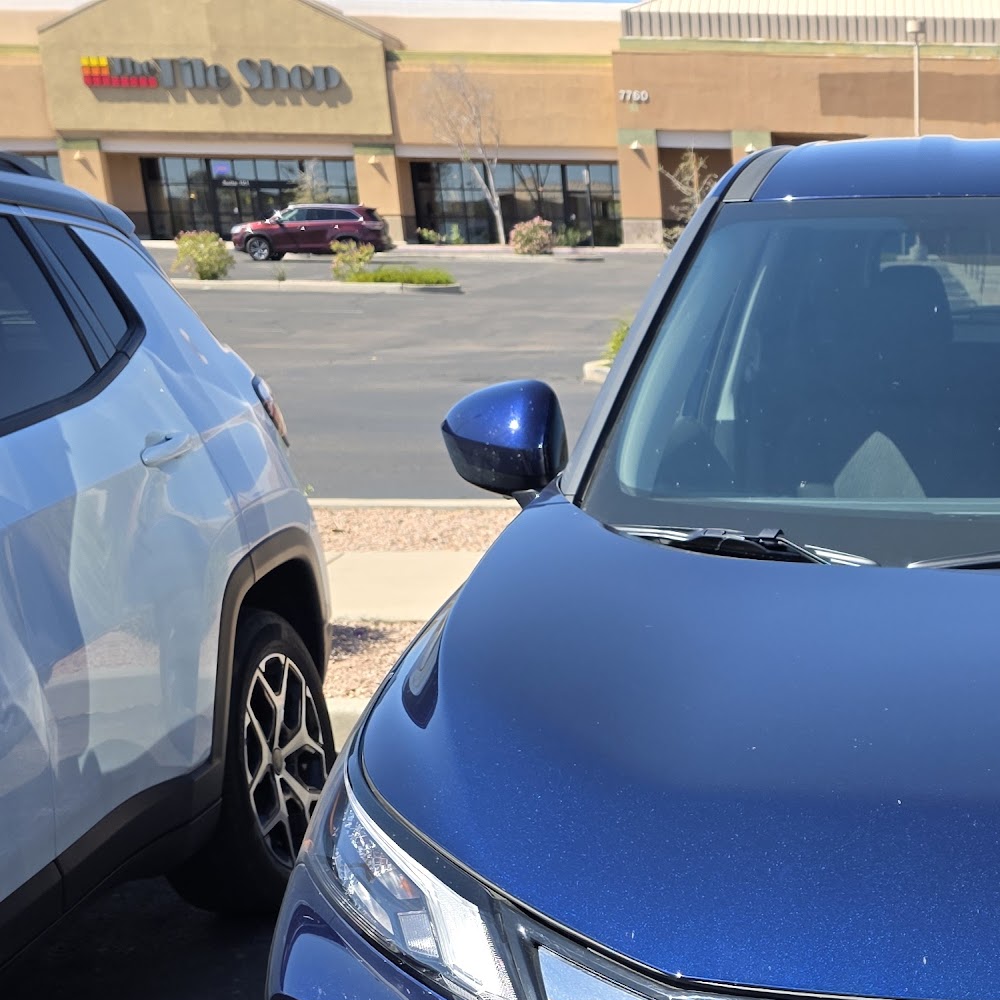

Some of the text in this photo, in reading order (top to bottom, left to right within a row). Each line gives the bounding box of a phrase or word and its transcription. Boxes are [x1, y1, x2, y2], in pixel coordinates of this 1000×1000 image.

[153, 58, 231, 91] Tile
[237, 58, 341, 92] Shop
[618, 89, 649, 102] 7760
